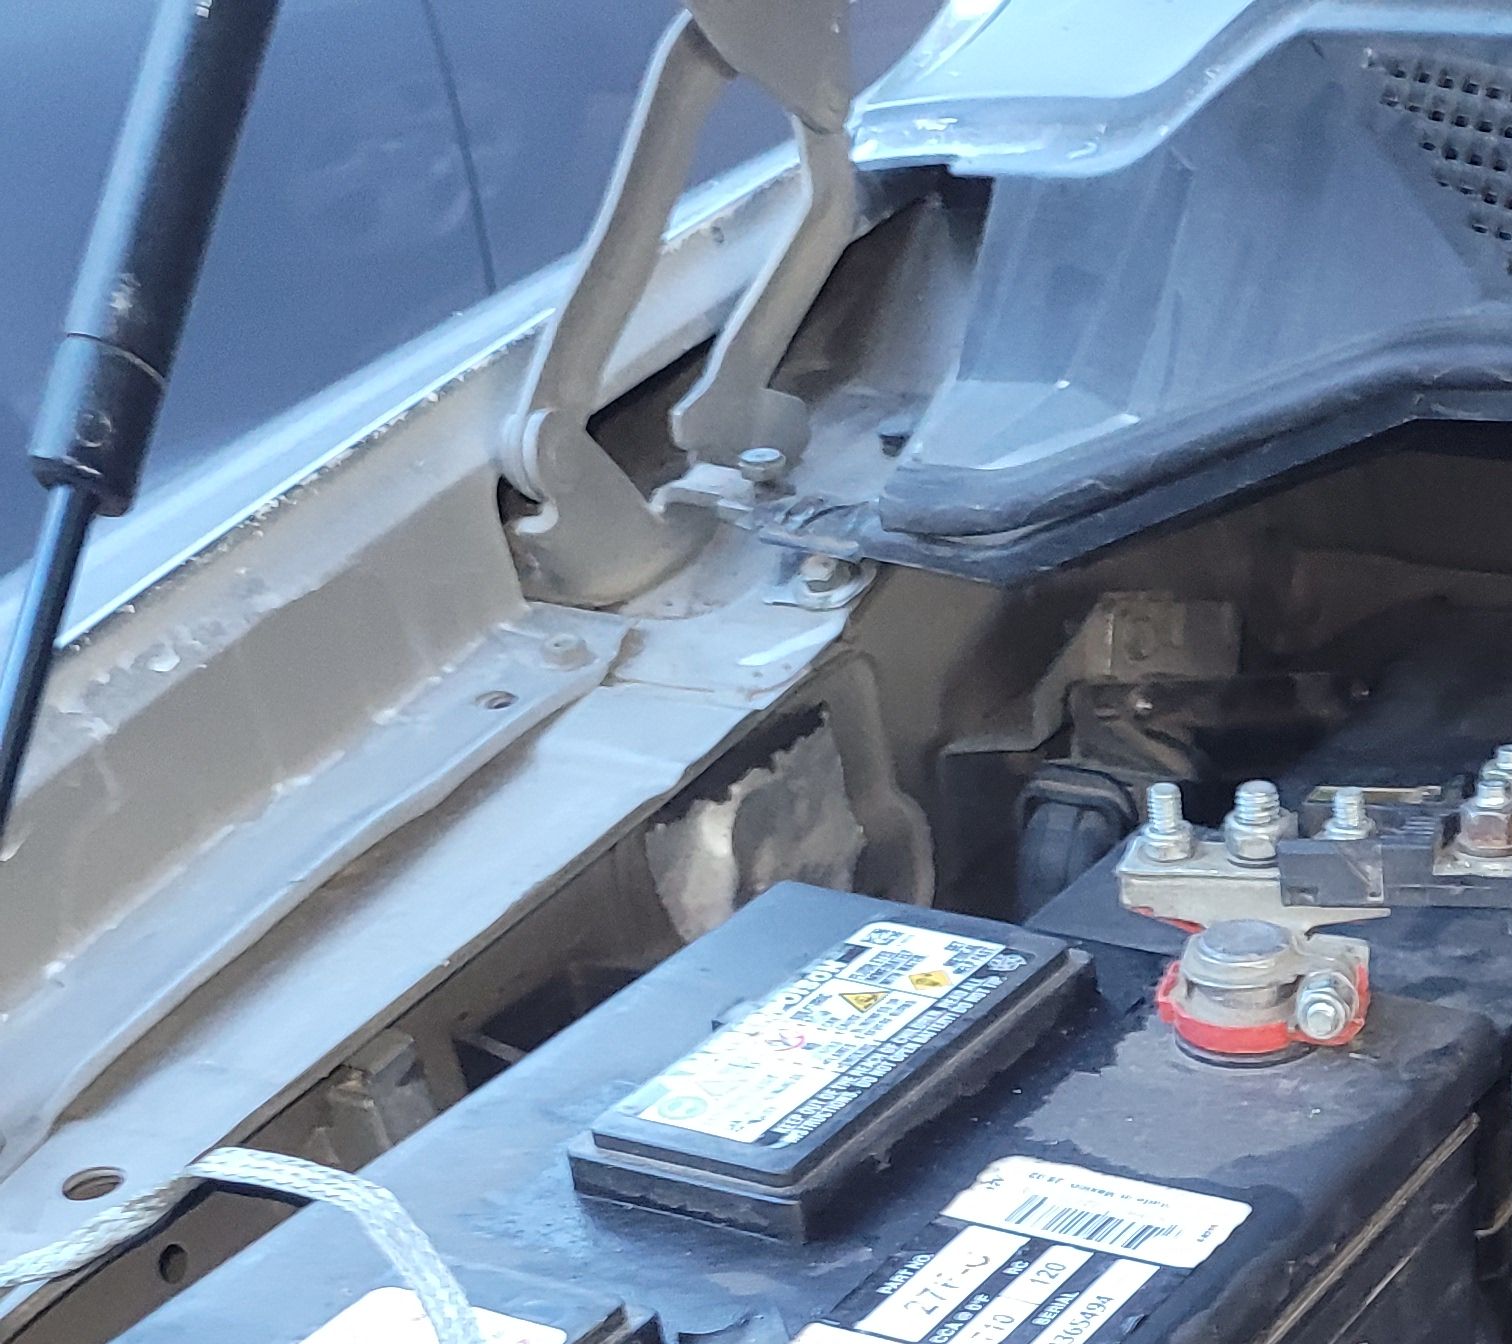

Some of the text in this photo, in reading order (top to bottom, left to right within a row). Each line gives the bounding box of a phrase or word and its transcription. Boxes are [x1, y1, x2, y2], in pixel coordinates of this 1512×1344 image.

[867, 1060, 898, 1077] NOT
[886, 1042, 923, 1062] OPEN
[963, 988, 992, 1003] NOT
[799, 1099, 826, 1117] OUT
[817, 1088, 839, 1102] OF
[845, 1052, 884, 1076] REACH
[876, 1267, 912, 1295] PART
[1002, 1258, 1031, 1277] RC
[1029, 1261, 1067, 1286] 120
[1031, 1291, 1081, 1328] SERIAL
[928, 1321, 963, 1344] CCA
